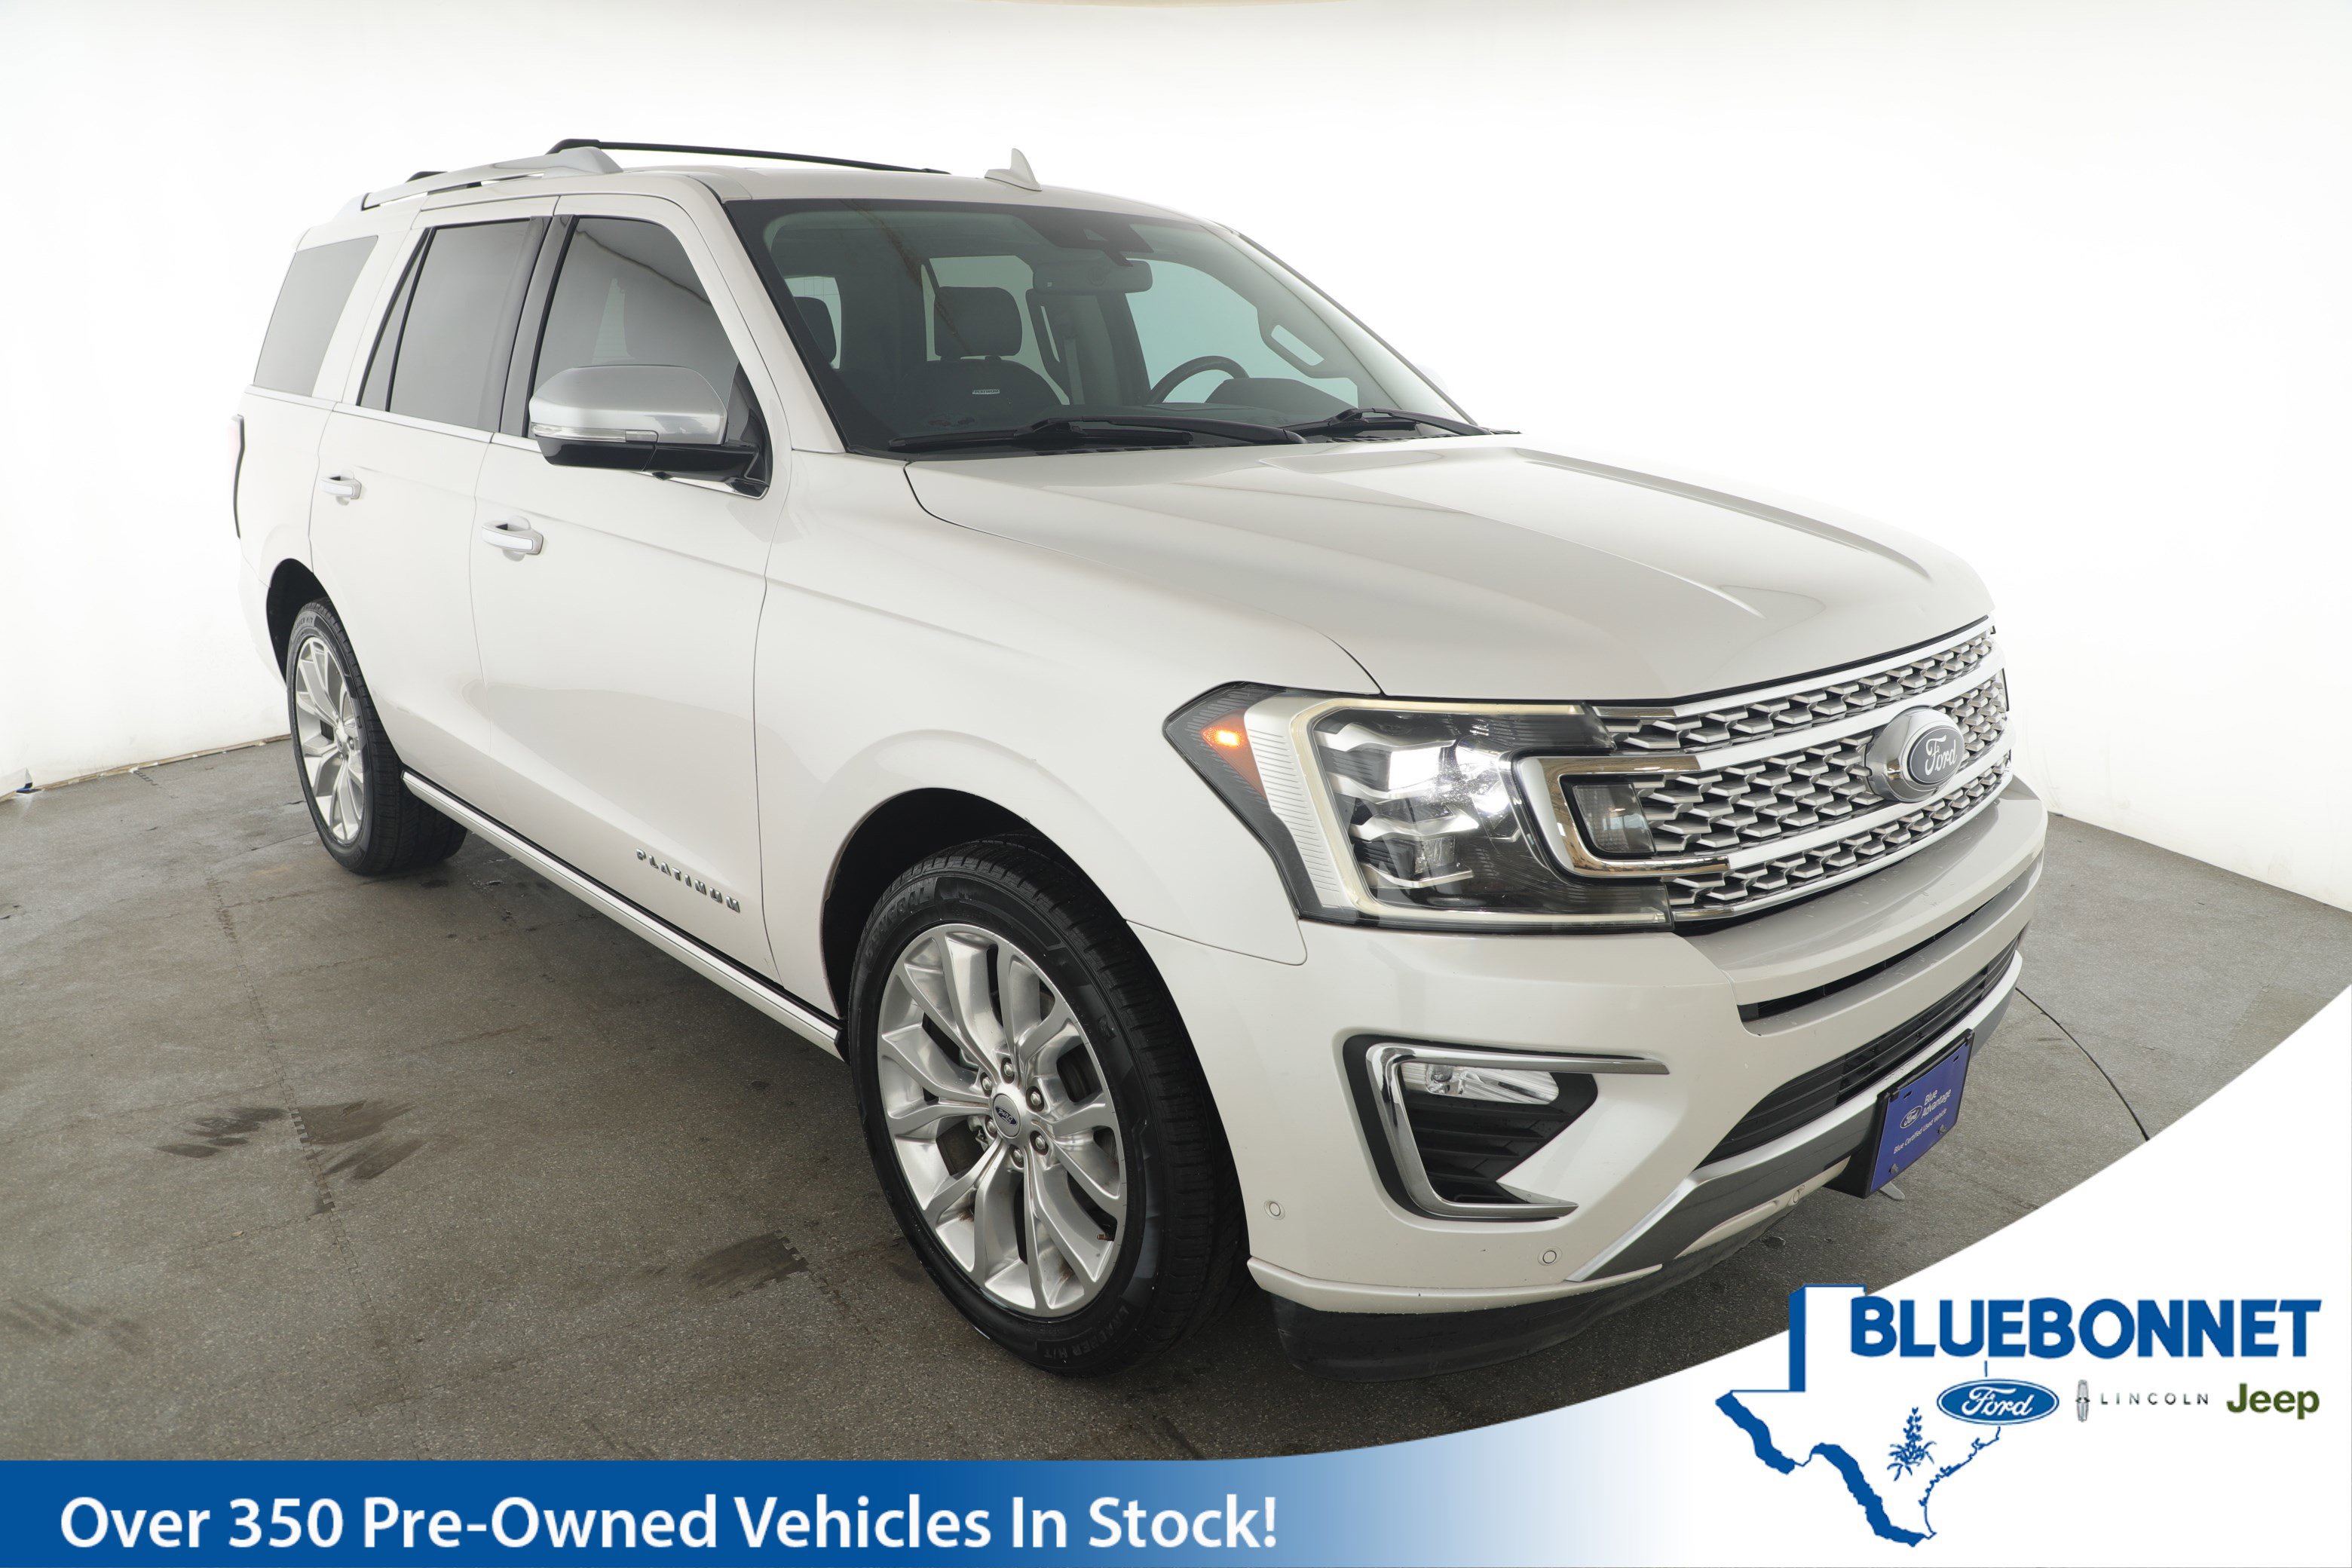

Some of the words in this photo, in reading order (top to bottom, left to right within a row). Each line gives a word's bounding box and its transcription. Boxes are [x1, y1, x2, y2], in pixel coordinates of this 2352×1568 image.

[1925, 735, 1958, 776] Ford
[636, 848, 740, 913] PLATINUM
[1922, 1089, 1952, 1119] Advantage
[1924, 1089, 1938, 1106] Blue
[1894, 1143, 1904, 1154] Blue
[1905, 1126, 1923, 1146] Certified
[1923, 1118, 1934, 1132] Used
